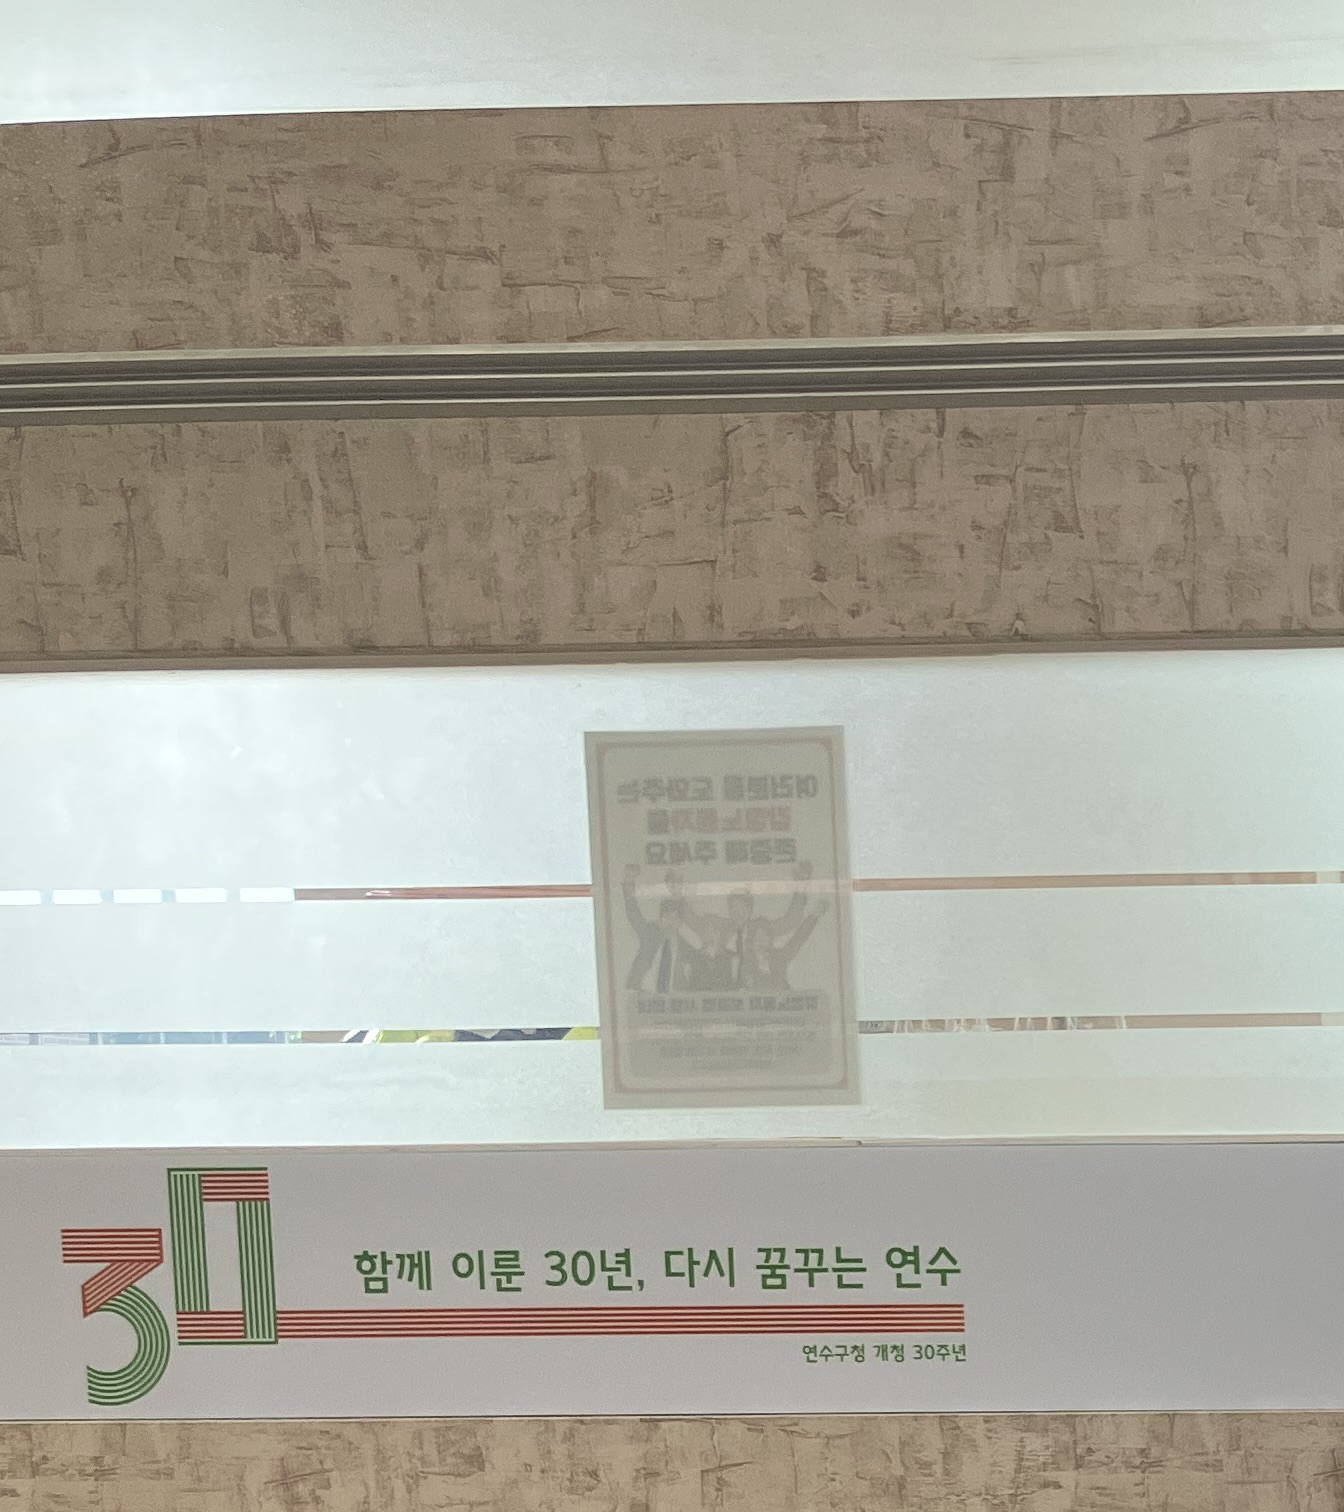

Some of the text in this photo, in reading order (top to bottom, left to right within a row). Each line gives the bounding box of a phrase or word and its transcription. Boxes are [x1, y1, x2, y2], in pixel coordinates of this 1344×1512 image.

[353, 1245, 962, 1294] 함께 이룬 30년, 다시 꿈꾸는 연수
[802, 1343, 967, 1364] 연수구청 개청 30주년
